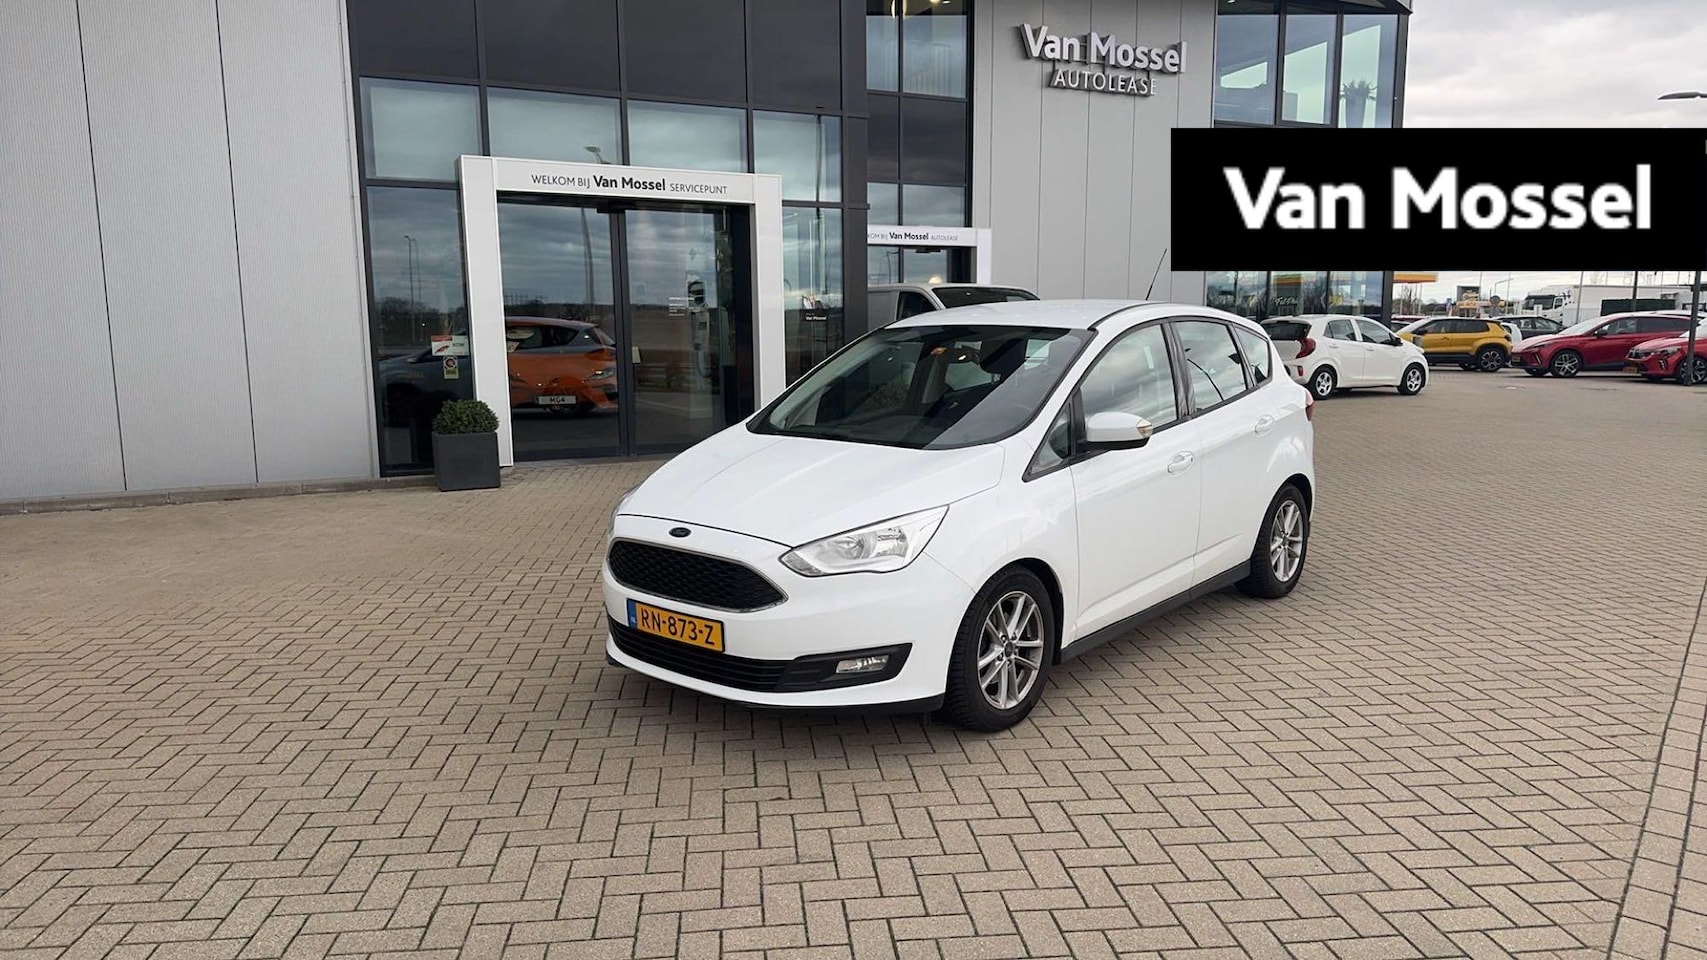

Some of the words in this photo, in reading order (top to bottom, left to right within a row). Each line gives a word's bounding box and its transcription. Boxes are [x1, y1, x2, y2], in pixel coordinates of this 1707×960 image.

[1021, 23, 1081, 61] Van
[1089, 32, 1188, 73] Mossel
[1053, 69, 1157, 95] AUTOLEASE
[531, 174, 576, 186] WELKOM
[577, 177, 591, 189] BIJ
[593, 175, 618, 188] Van
[621, 176, 666, 191] Mossel
[669, 183, 728, 194] SERVICEPUNT
[889, 231, 903, 240] Van
[904, 232, 929, 240] Mossel
[641, 608, 715, 645] RN-873-Z
